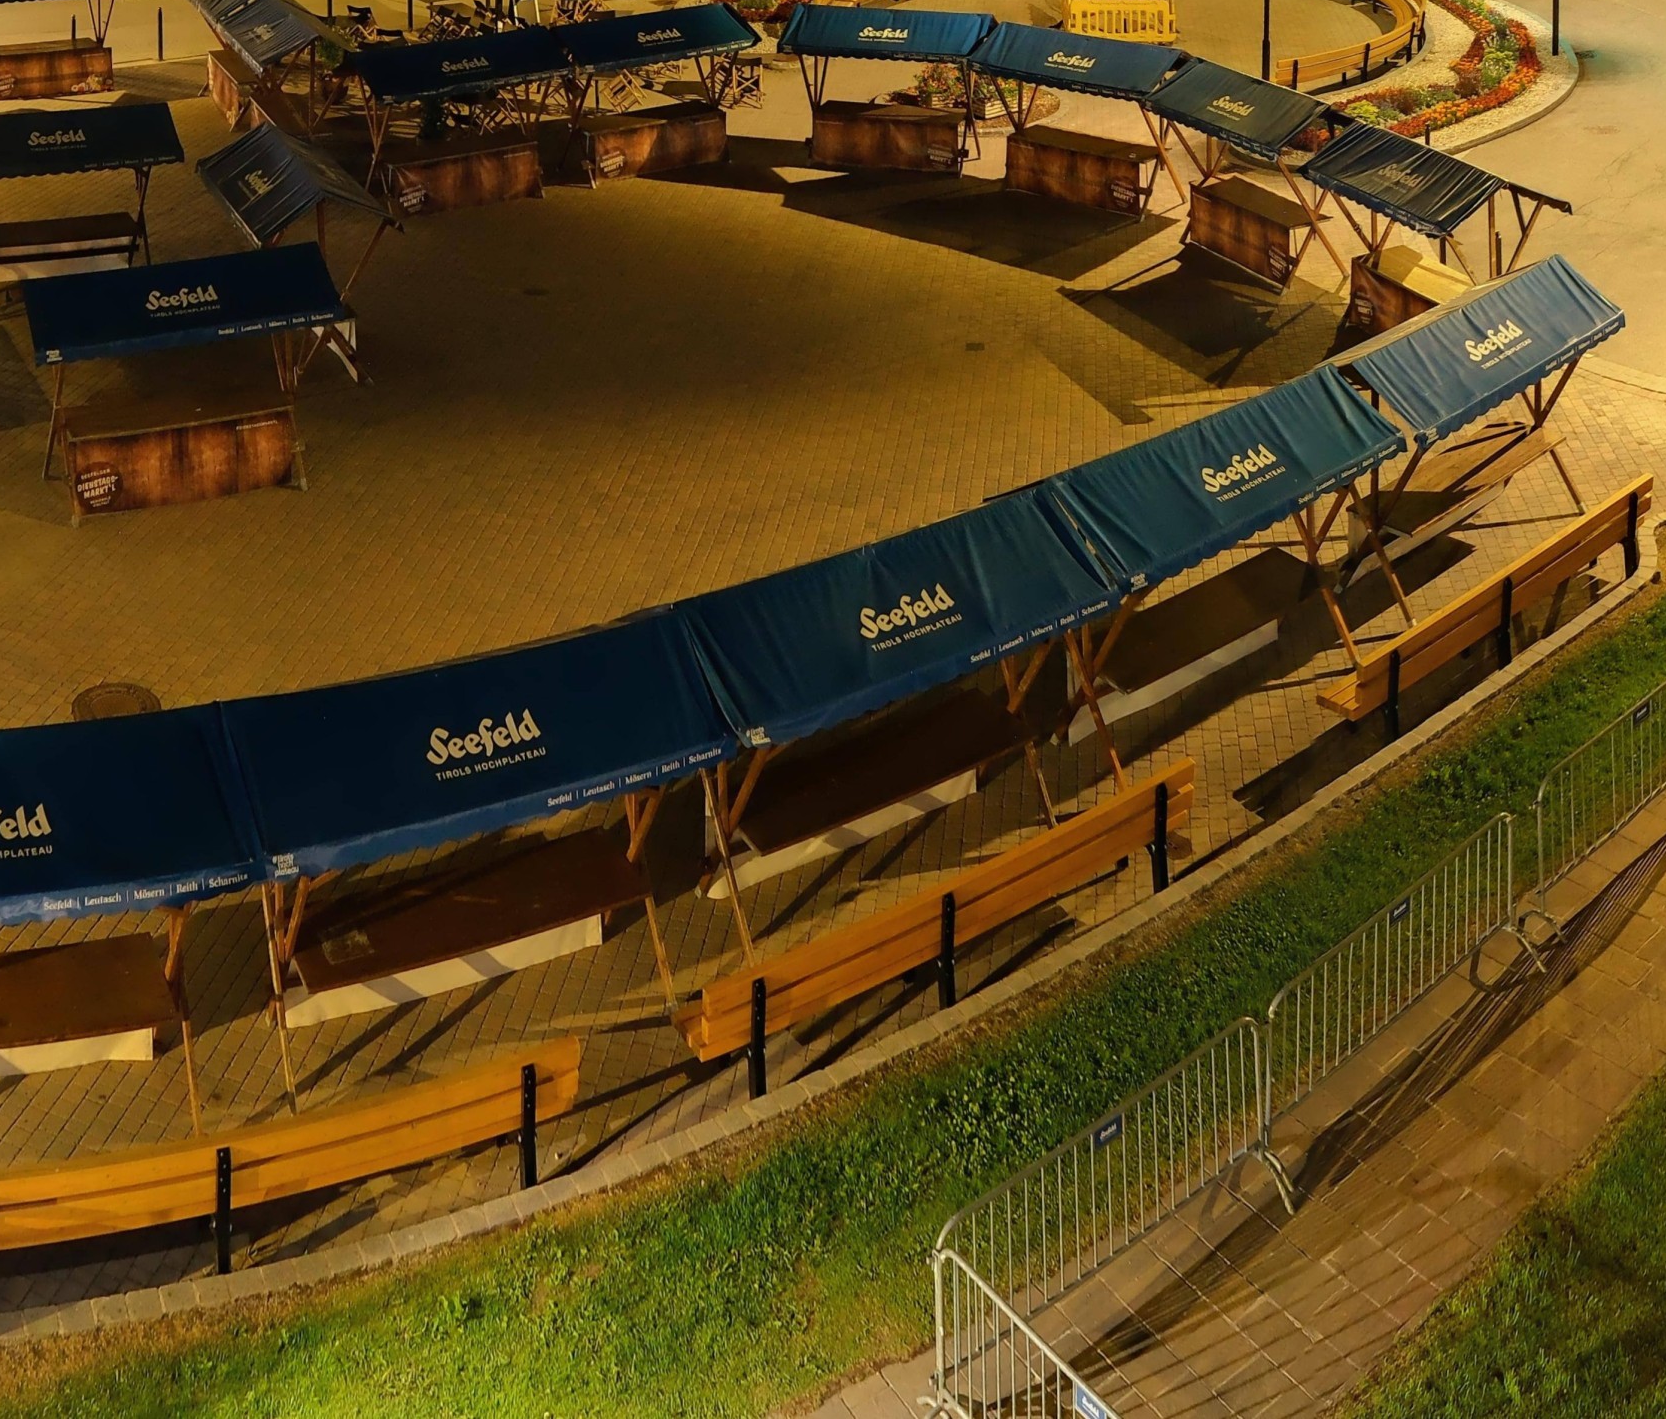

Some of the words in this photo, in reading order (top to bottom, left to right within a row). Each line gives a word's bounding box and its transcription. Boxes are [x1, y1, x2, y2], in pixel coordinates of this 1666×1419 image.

[637, 28, 681, 43] Seefeld
[859, 27, 908, 38] Seefeld
[441, 56, 489, 72] Seefeld
[1047, 51, 1096, 68] Seefeld
[28, 129, 86, 145] Seefeld
[145, 284, 218, 310] Seefeld
[1465, 319, 1524, 361] Seefeld
[1202, 443, 1277, 493] Seefeld
[1215, 489, 1241, 503] TIROLS
[859, 583, 955, 640] Seefeld
[871, 636, 903, 653] TIROLS
[903, 613, 963, 641] HOCHPLATEAU
[426, 707, 542, 766] Seefeld
[436, 765, 472, 782] TIROLS
[474, 747, 547, 773] HOCHPLATEAU
[546, 793, 572, 807] Seefeld
[582, 781, 615, 798] Leutasch
[624, 770, 652, 786] Mösern
[661, 760, 680, 774] Reith
[688, 747, 722, 764] Scharnitz
[44, 899, 73, 911] Seefeld
[84, 892, 122, 906] Leutasch
[133, 888, 165, 900] Mösern
[176, 882, 199, 894] Reith
[209, 873, 249, 889] Scharnitz
